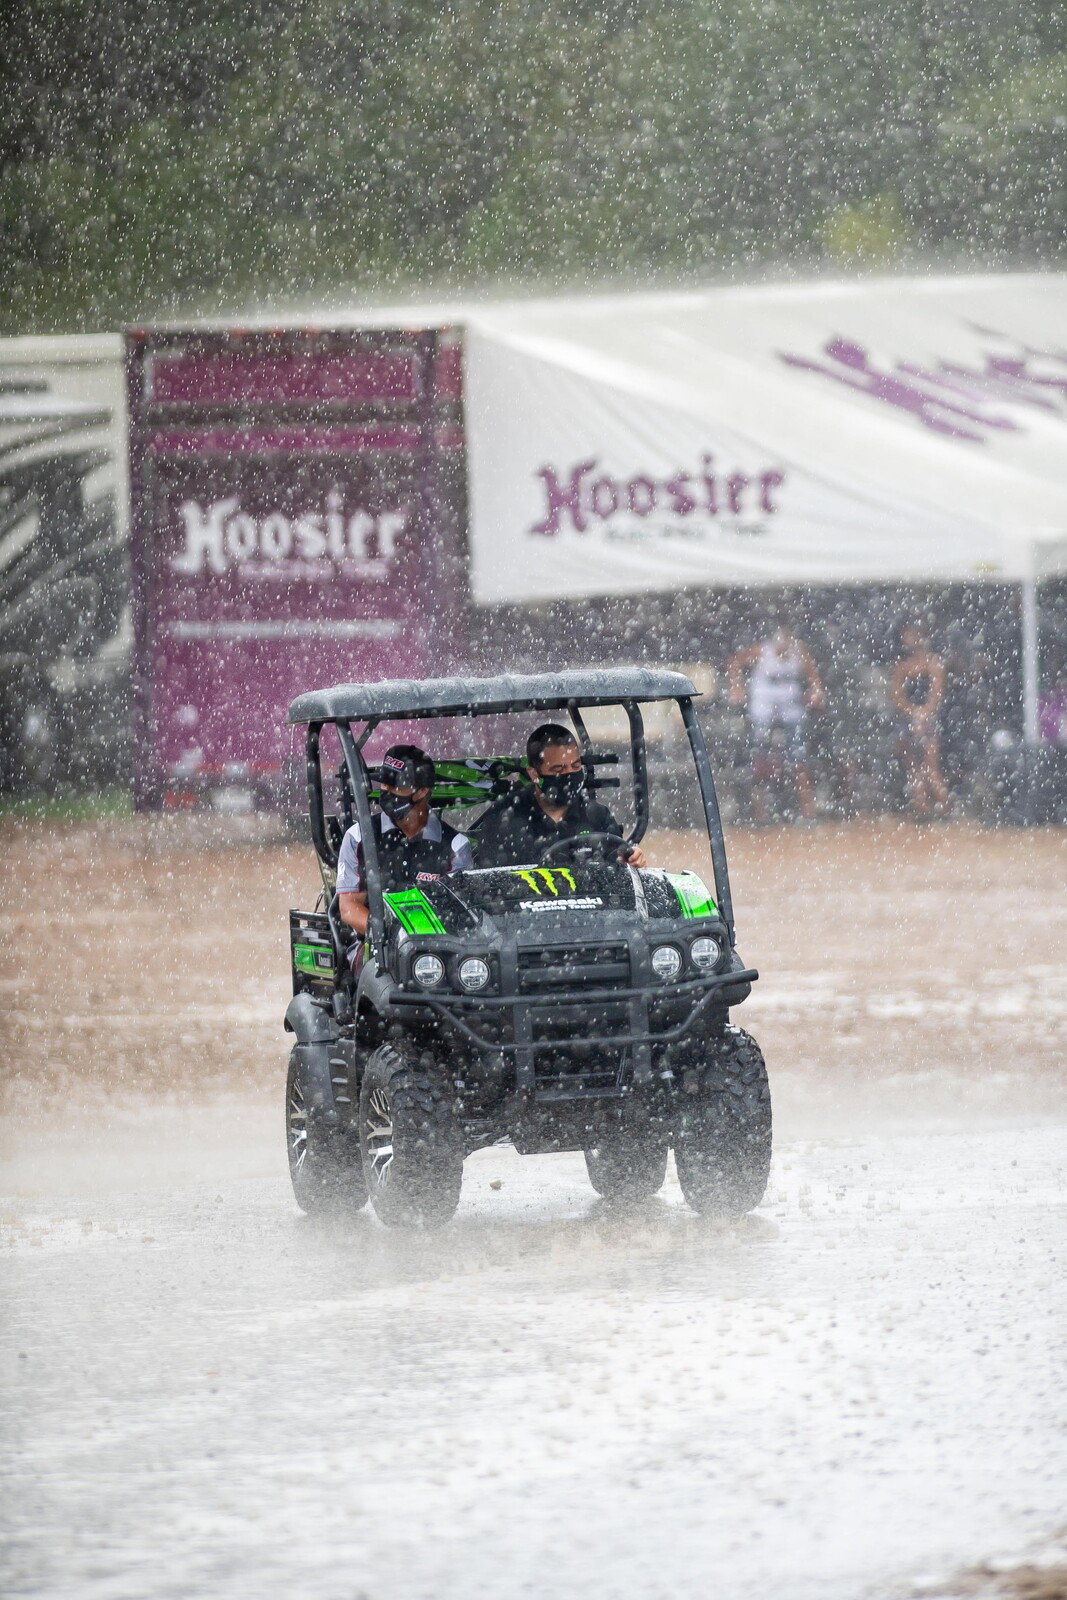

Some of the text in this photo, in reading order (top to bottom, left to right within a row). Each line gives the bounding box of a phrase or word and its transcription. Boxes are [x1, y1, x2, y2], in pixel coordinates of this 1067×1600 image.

[171, 488, 408, 576] Hoosier
[529, 453, 786, 536] Hoosier
[519, 897, 603, 909] Kawasaki
